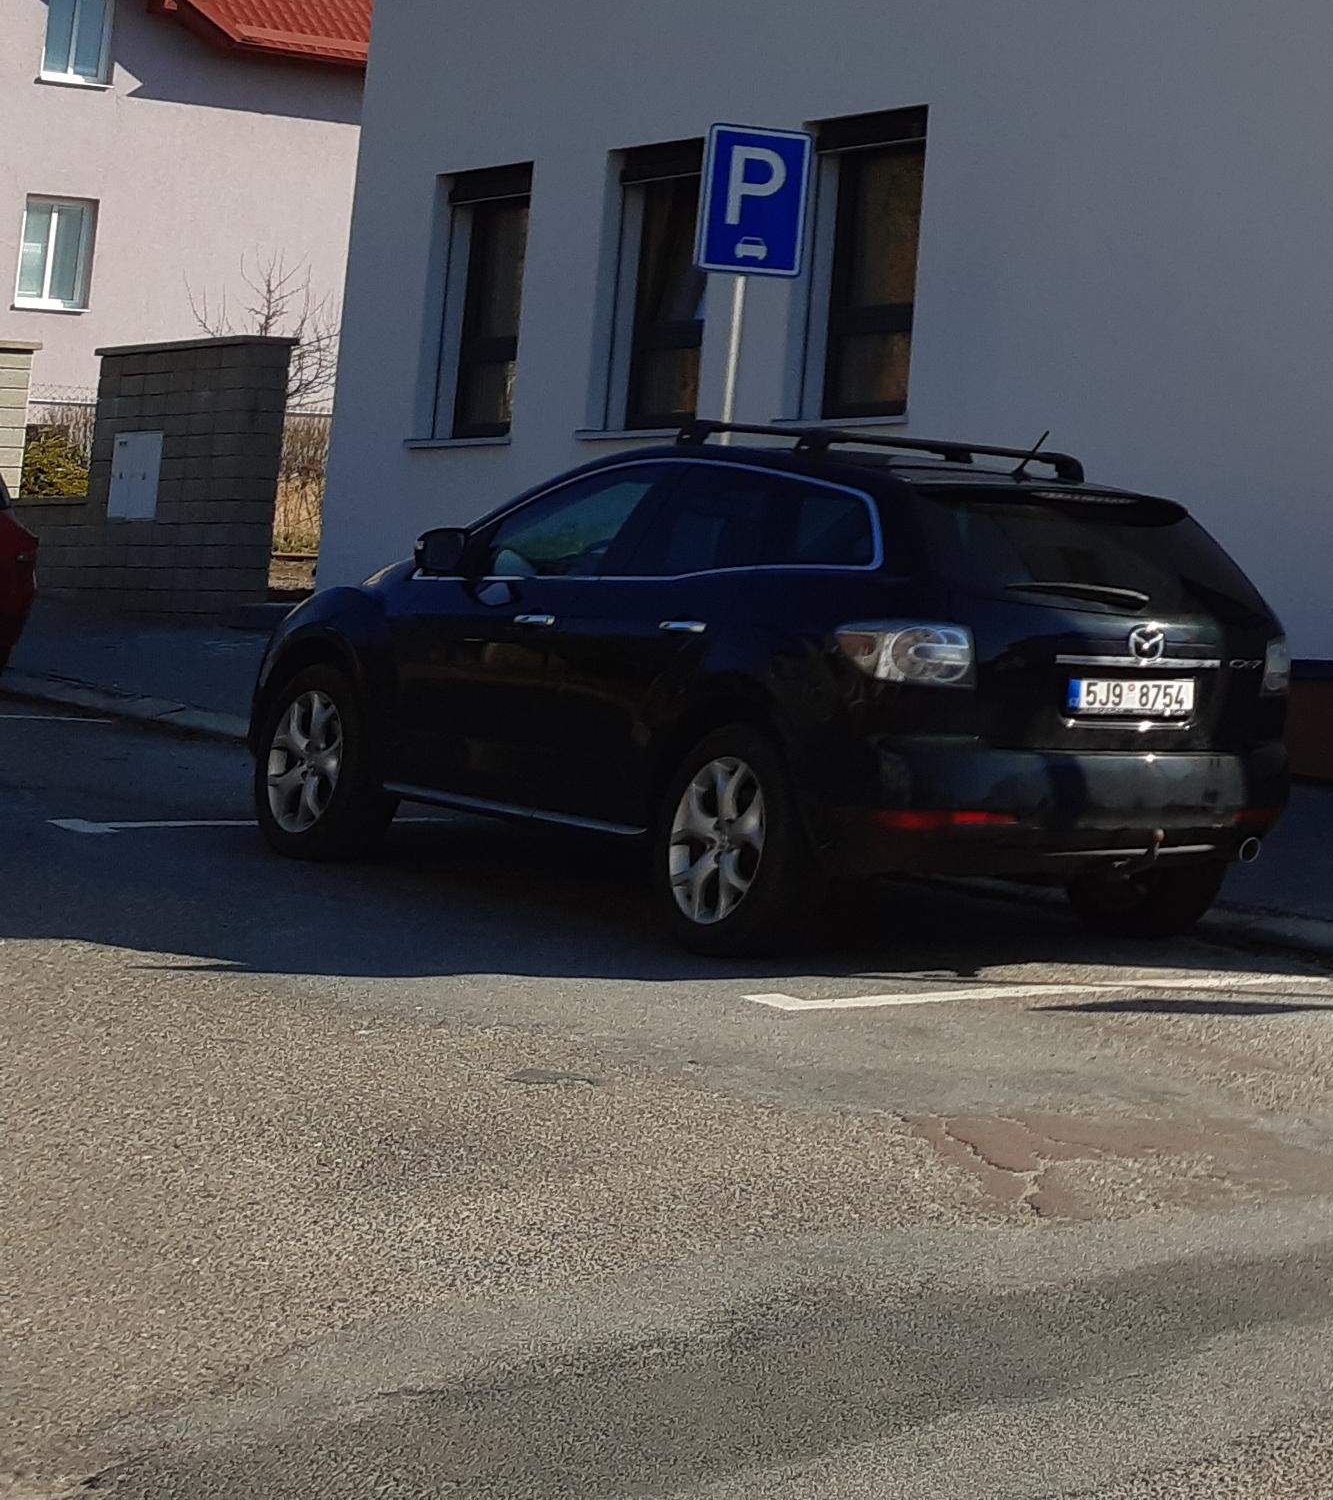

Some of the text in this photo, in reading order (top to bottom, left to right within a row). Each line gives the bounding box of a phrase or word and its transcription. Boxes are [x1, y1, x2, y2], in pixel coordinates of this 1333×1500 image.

[725, 145, 787, 224] P
[1085, 682, 1185, 709] 5J9 8754
